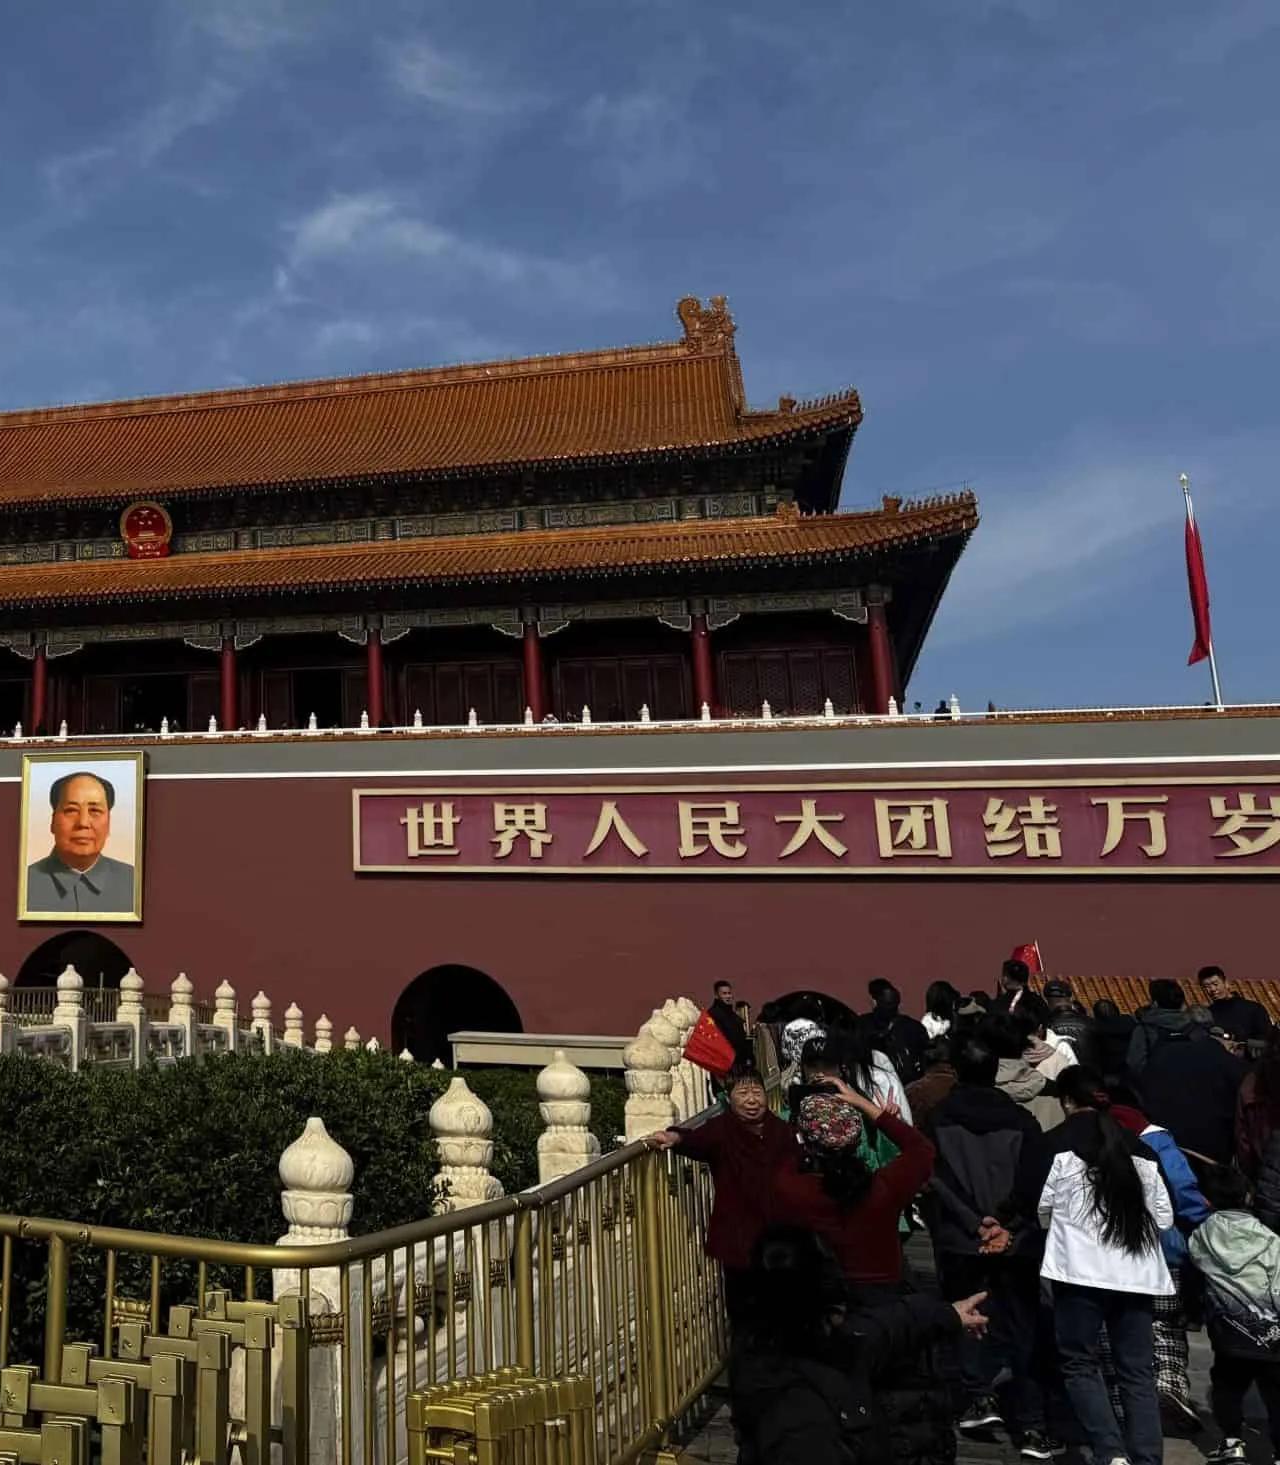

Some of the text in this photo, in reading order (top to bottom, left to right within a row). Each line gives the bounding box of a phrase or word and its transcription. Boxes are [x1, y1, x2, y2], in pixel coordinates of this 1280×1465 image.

[400, 792, 1280, 858] 世界人民大团结万岁
